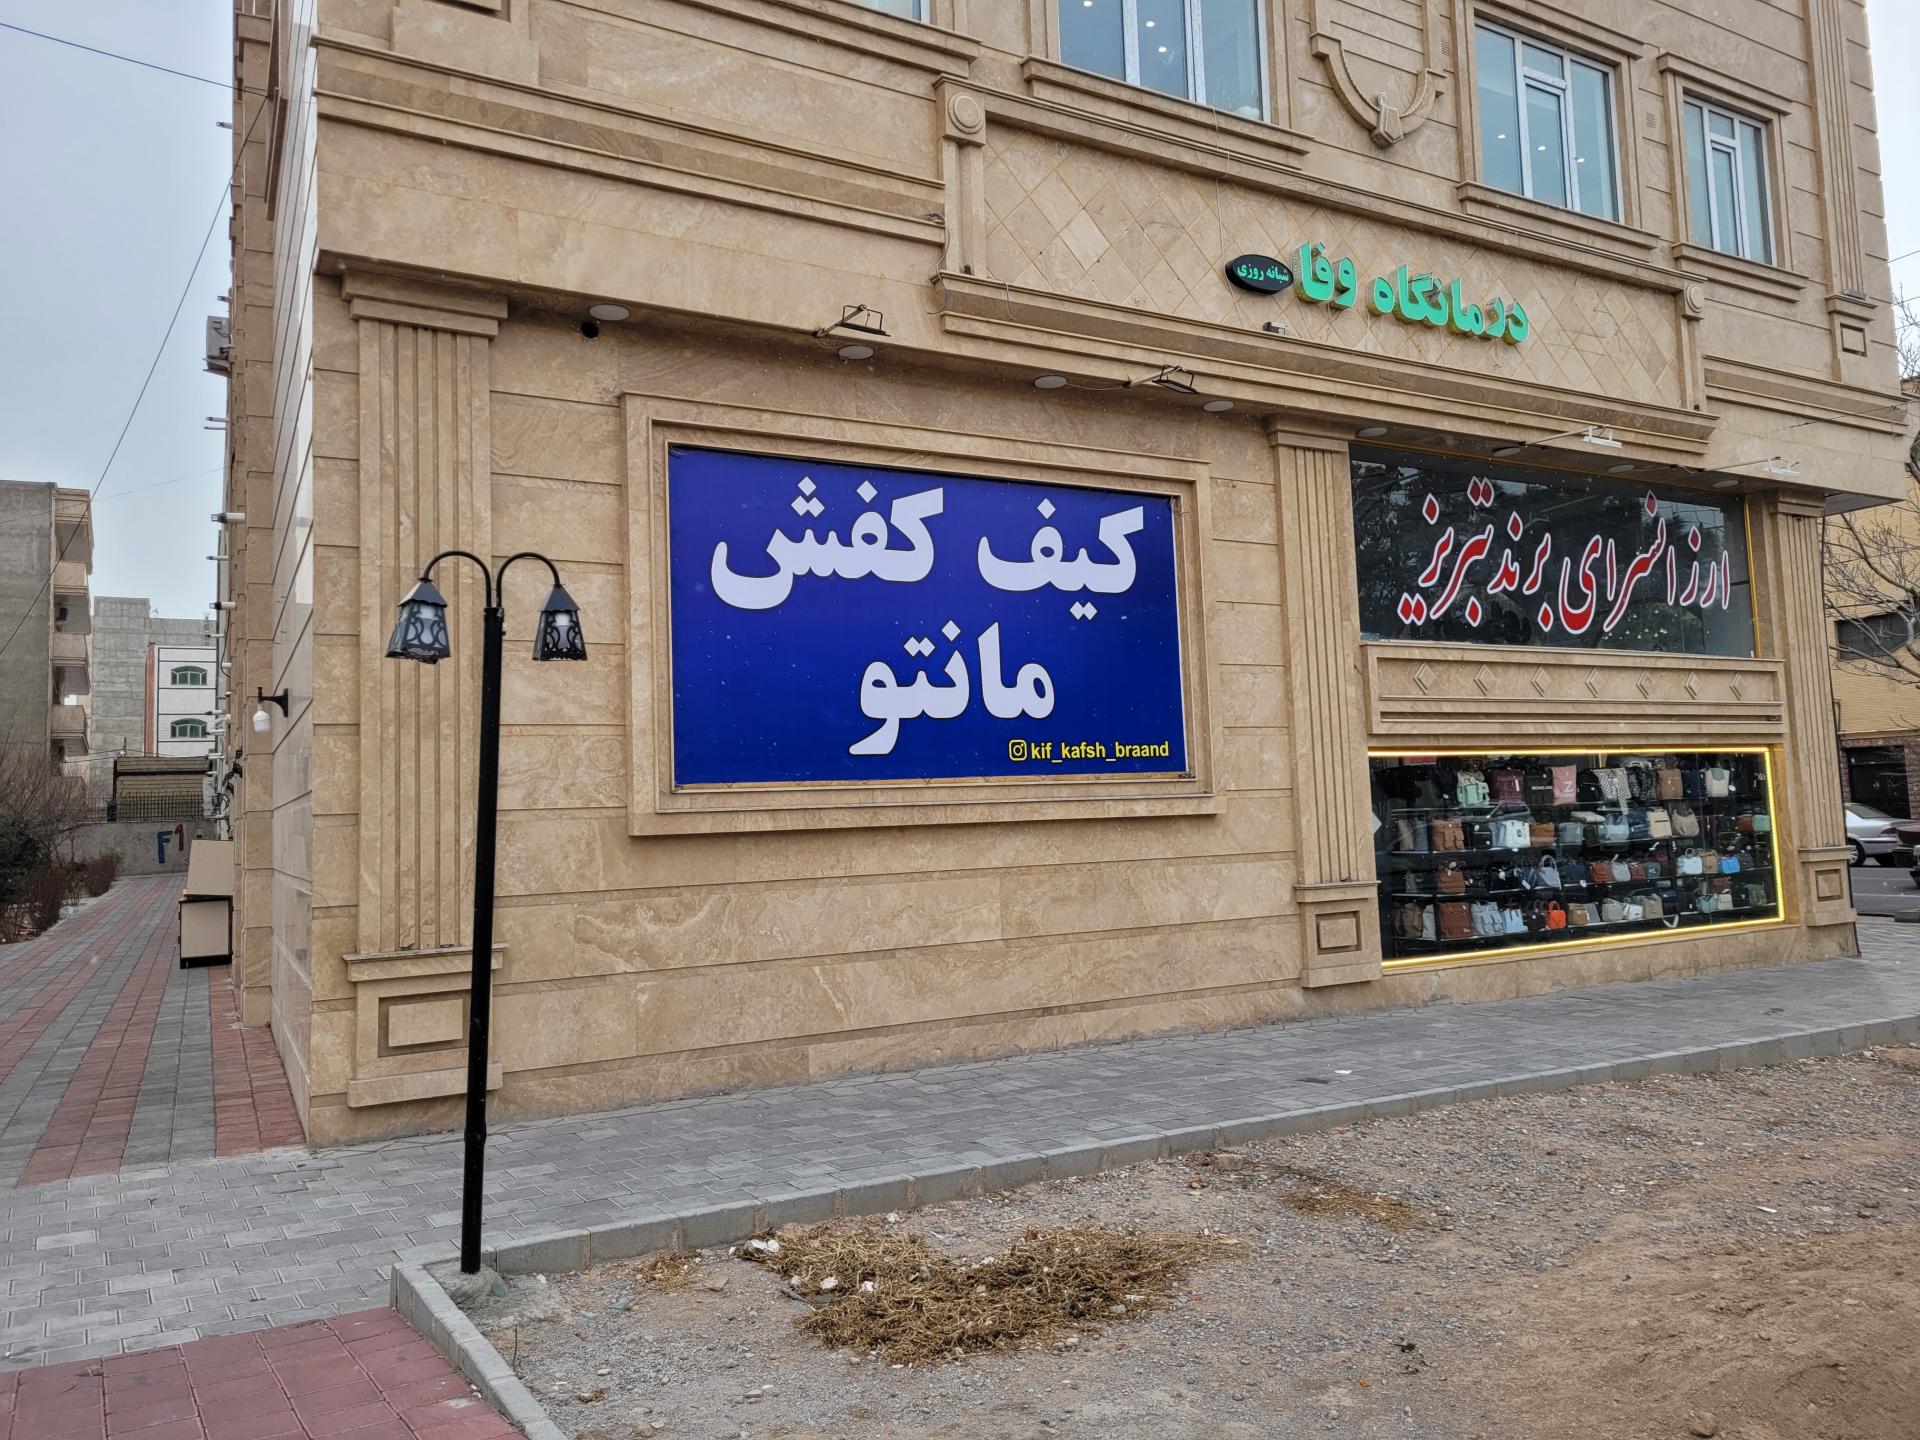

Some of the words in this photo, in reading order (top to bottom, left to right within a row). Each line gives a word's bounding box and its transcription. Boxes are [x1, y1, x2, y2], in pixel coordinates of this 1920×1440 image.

[1237, 263, 1264, 281] روزی
[1266, 265, 1289, 284] شبانه
[1299, 240, 1357, 307] وفا
[1371, 263, 1530, 342] درمانگاه
[710, 475, 944, 611] کفش
[976, 497, 1144, 621] کیف
[1397, 475, 1495, 626] تبریز
[1487, 510, 1552, 632] برند
[847, 619, 1056, 756] مانتو
[1030, 740, 1170, 764] kif_kafsh_braand
